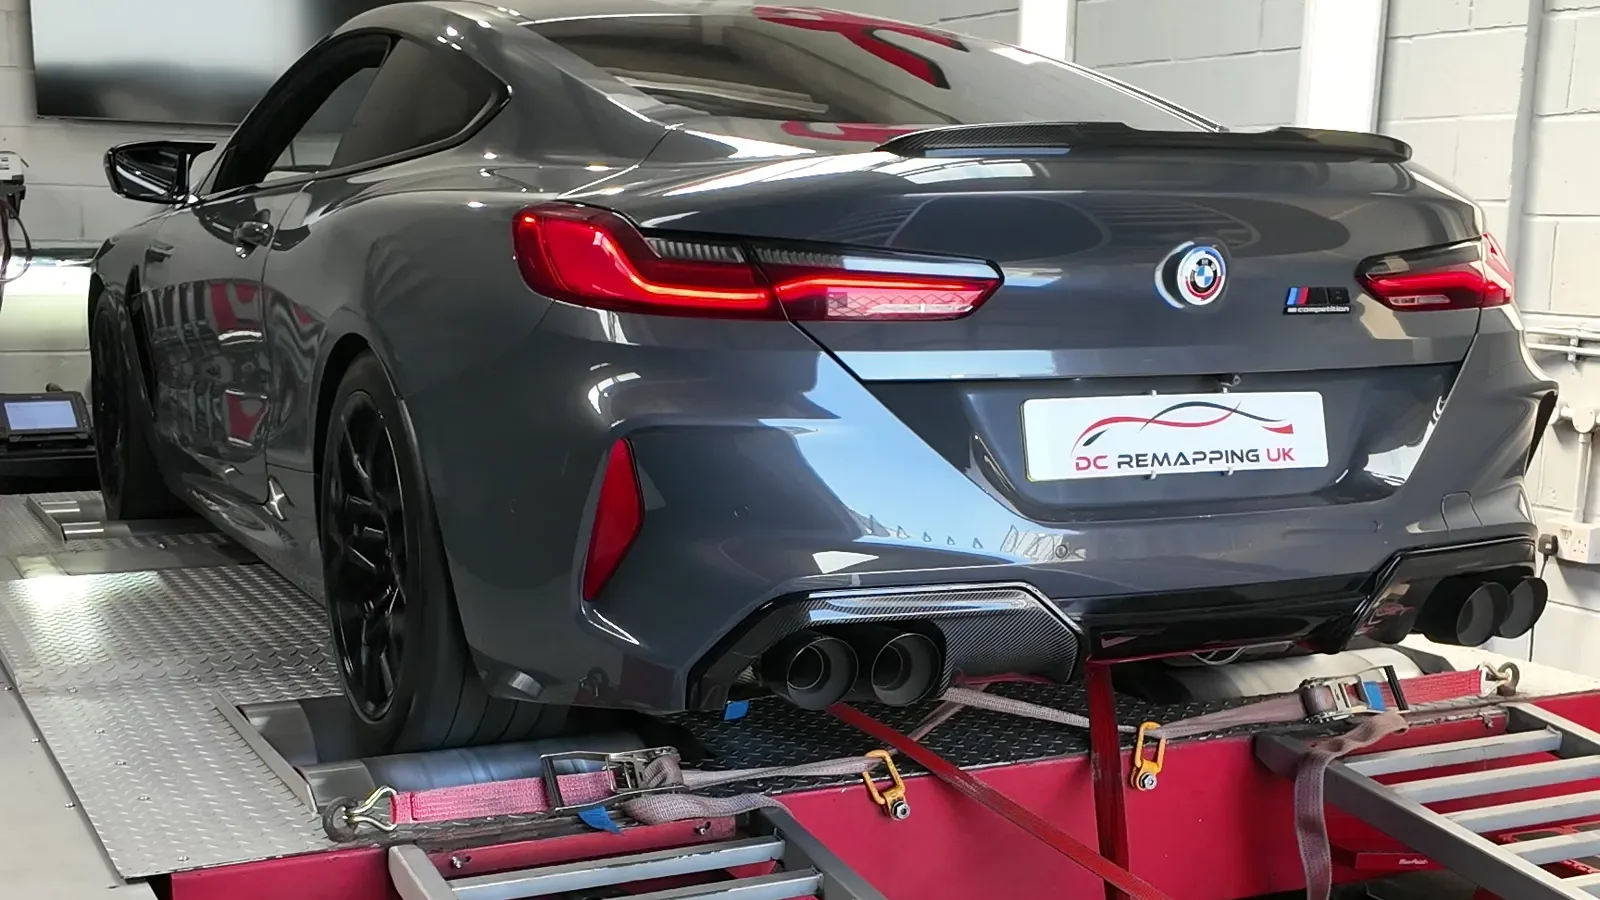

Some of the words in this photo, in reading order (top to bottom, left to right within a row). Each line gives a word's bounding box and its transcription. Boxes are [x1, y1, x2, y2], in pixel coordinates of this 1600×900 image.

[1297, 305, 1350, 314] competition
[1075, 455, 1109, 471] DC
[1117, 448, 1260, 469] REMAPPING
[1266, 447, 1295, 462] UK
